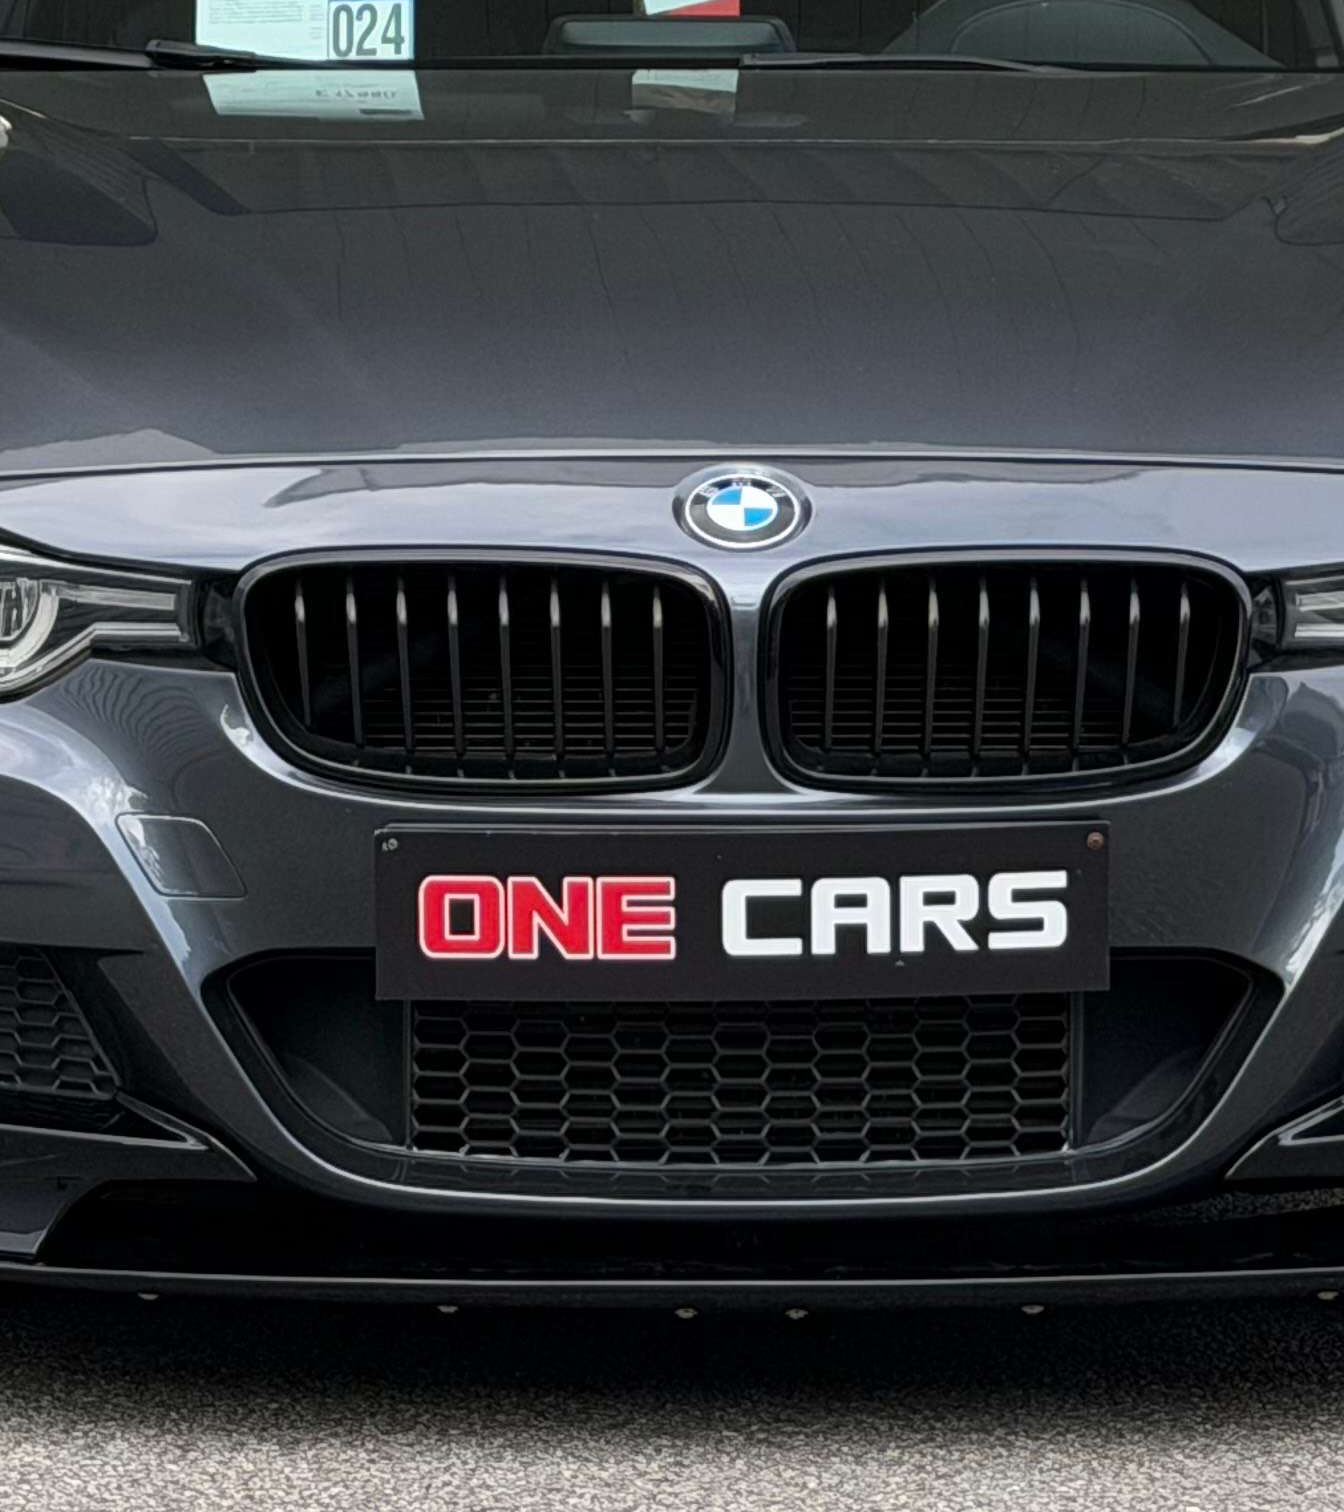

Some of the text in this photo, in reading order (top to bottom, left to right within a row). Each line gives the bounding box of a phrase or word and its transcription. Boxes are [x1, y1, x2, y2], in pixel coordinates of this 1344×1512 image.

[332, 3, 405, 59] 024
[418, 869, 1068, 960] ONE CARS
